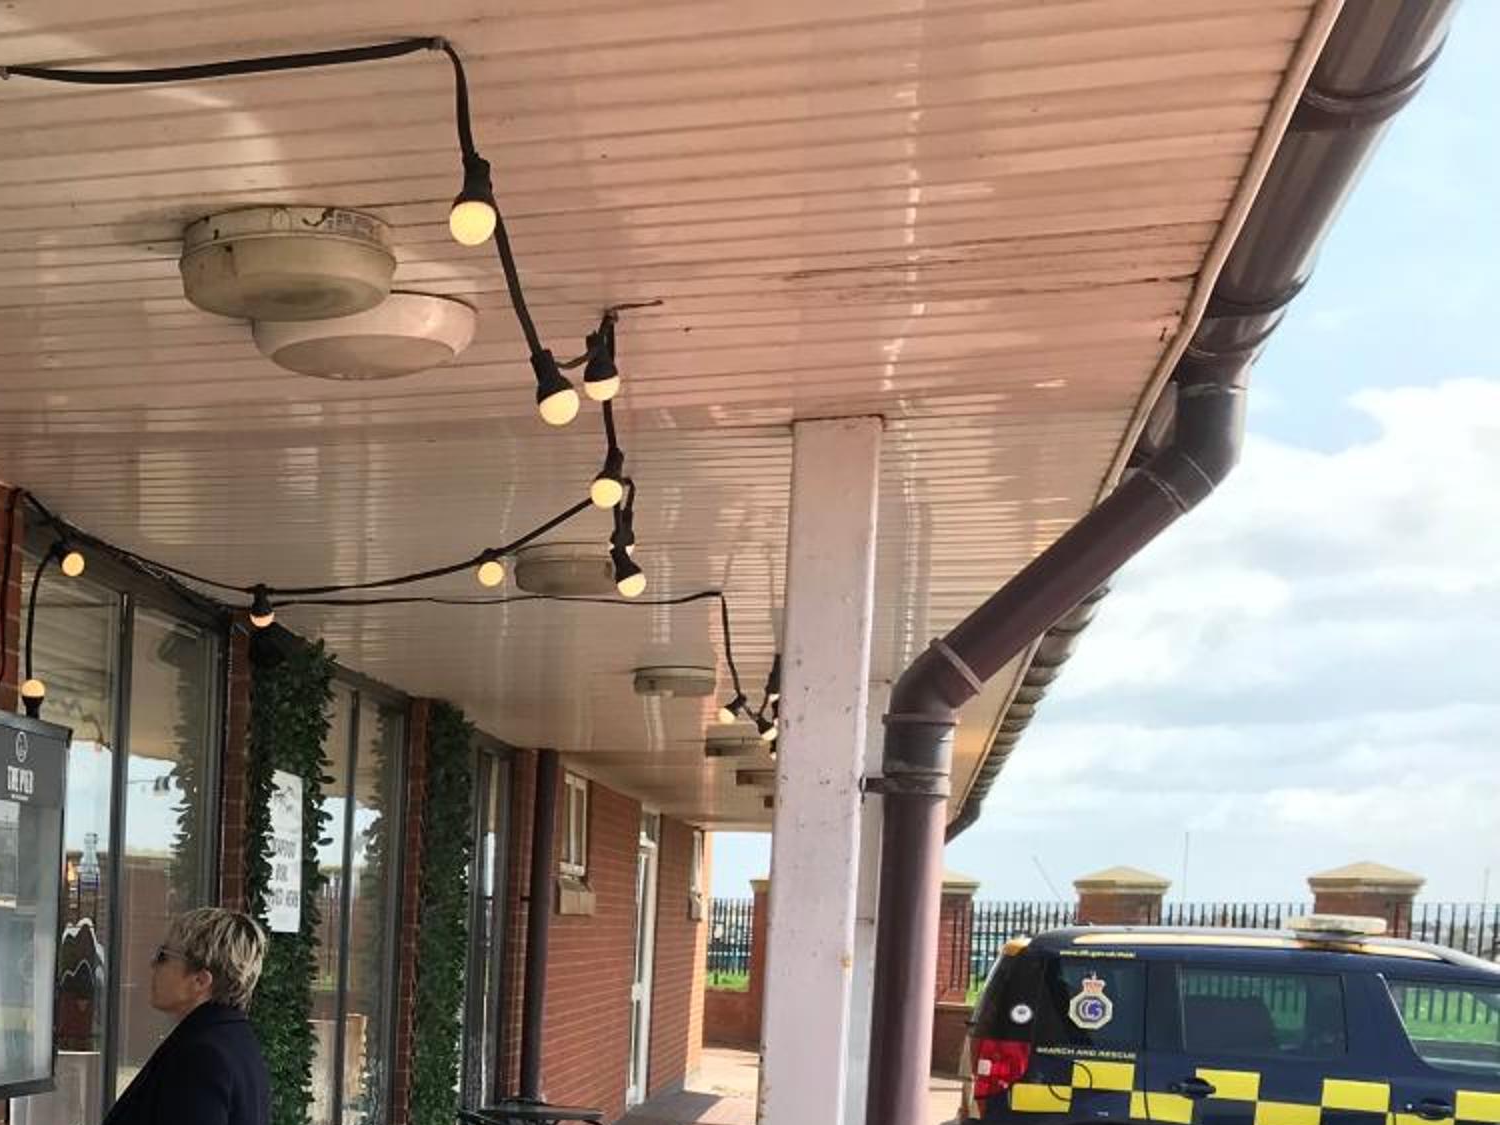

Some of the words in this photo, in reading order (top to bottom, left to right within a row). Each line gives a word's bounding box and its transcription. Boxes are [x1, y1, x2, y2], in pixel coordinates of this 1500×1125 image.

[7, 765, 20, 792] THE
[1036, 1047, 1075, 1056] SEARCH
[1076, 1049, 1097, 1057] AND
[1098, 1051, 1136, 1060] RESCUE
